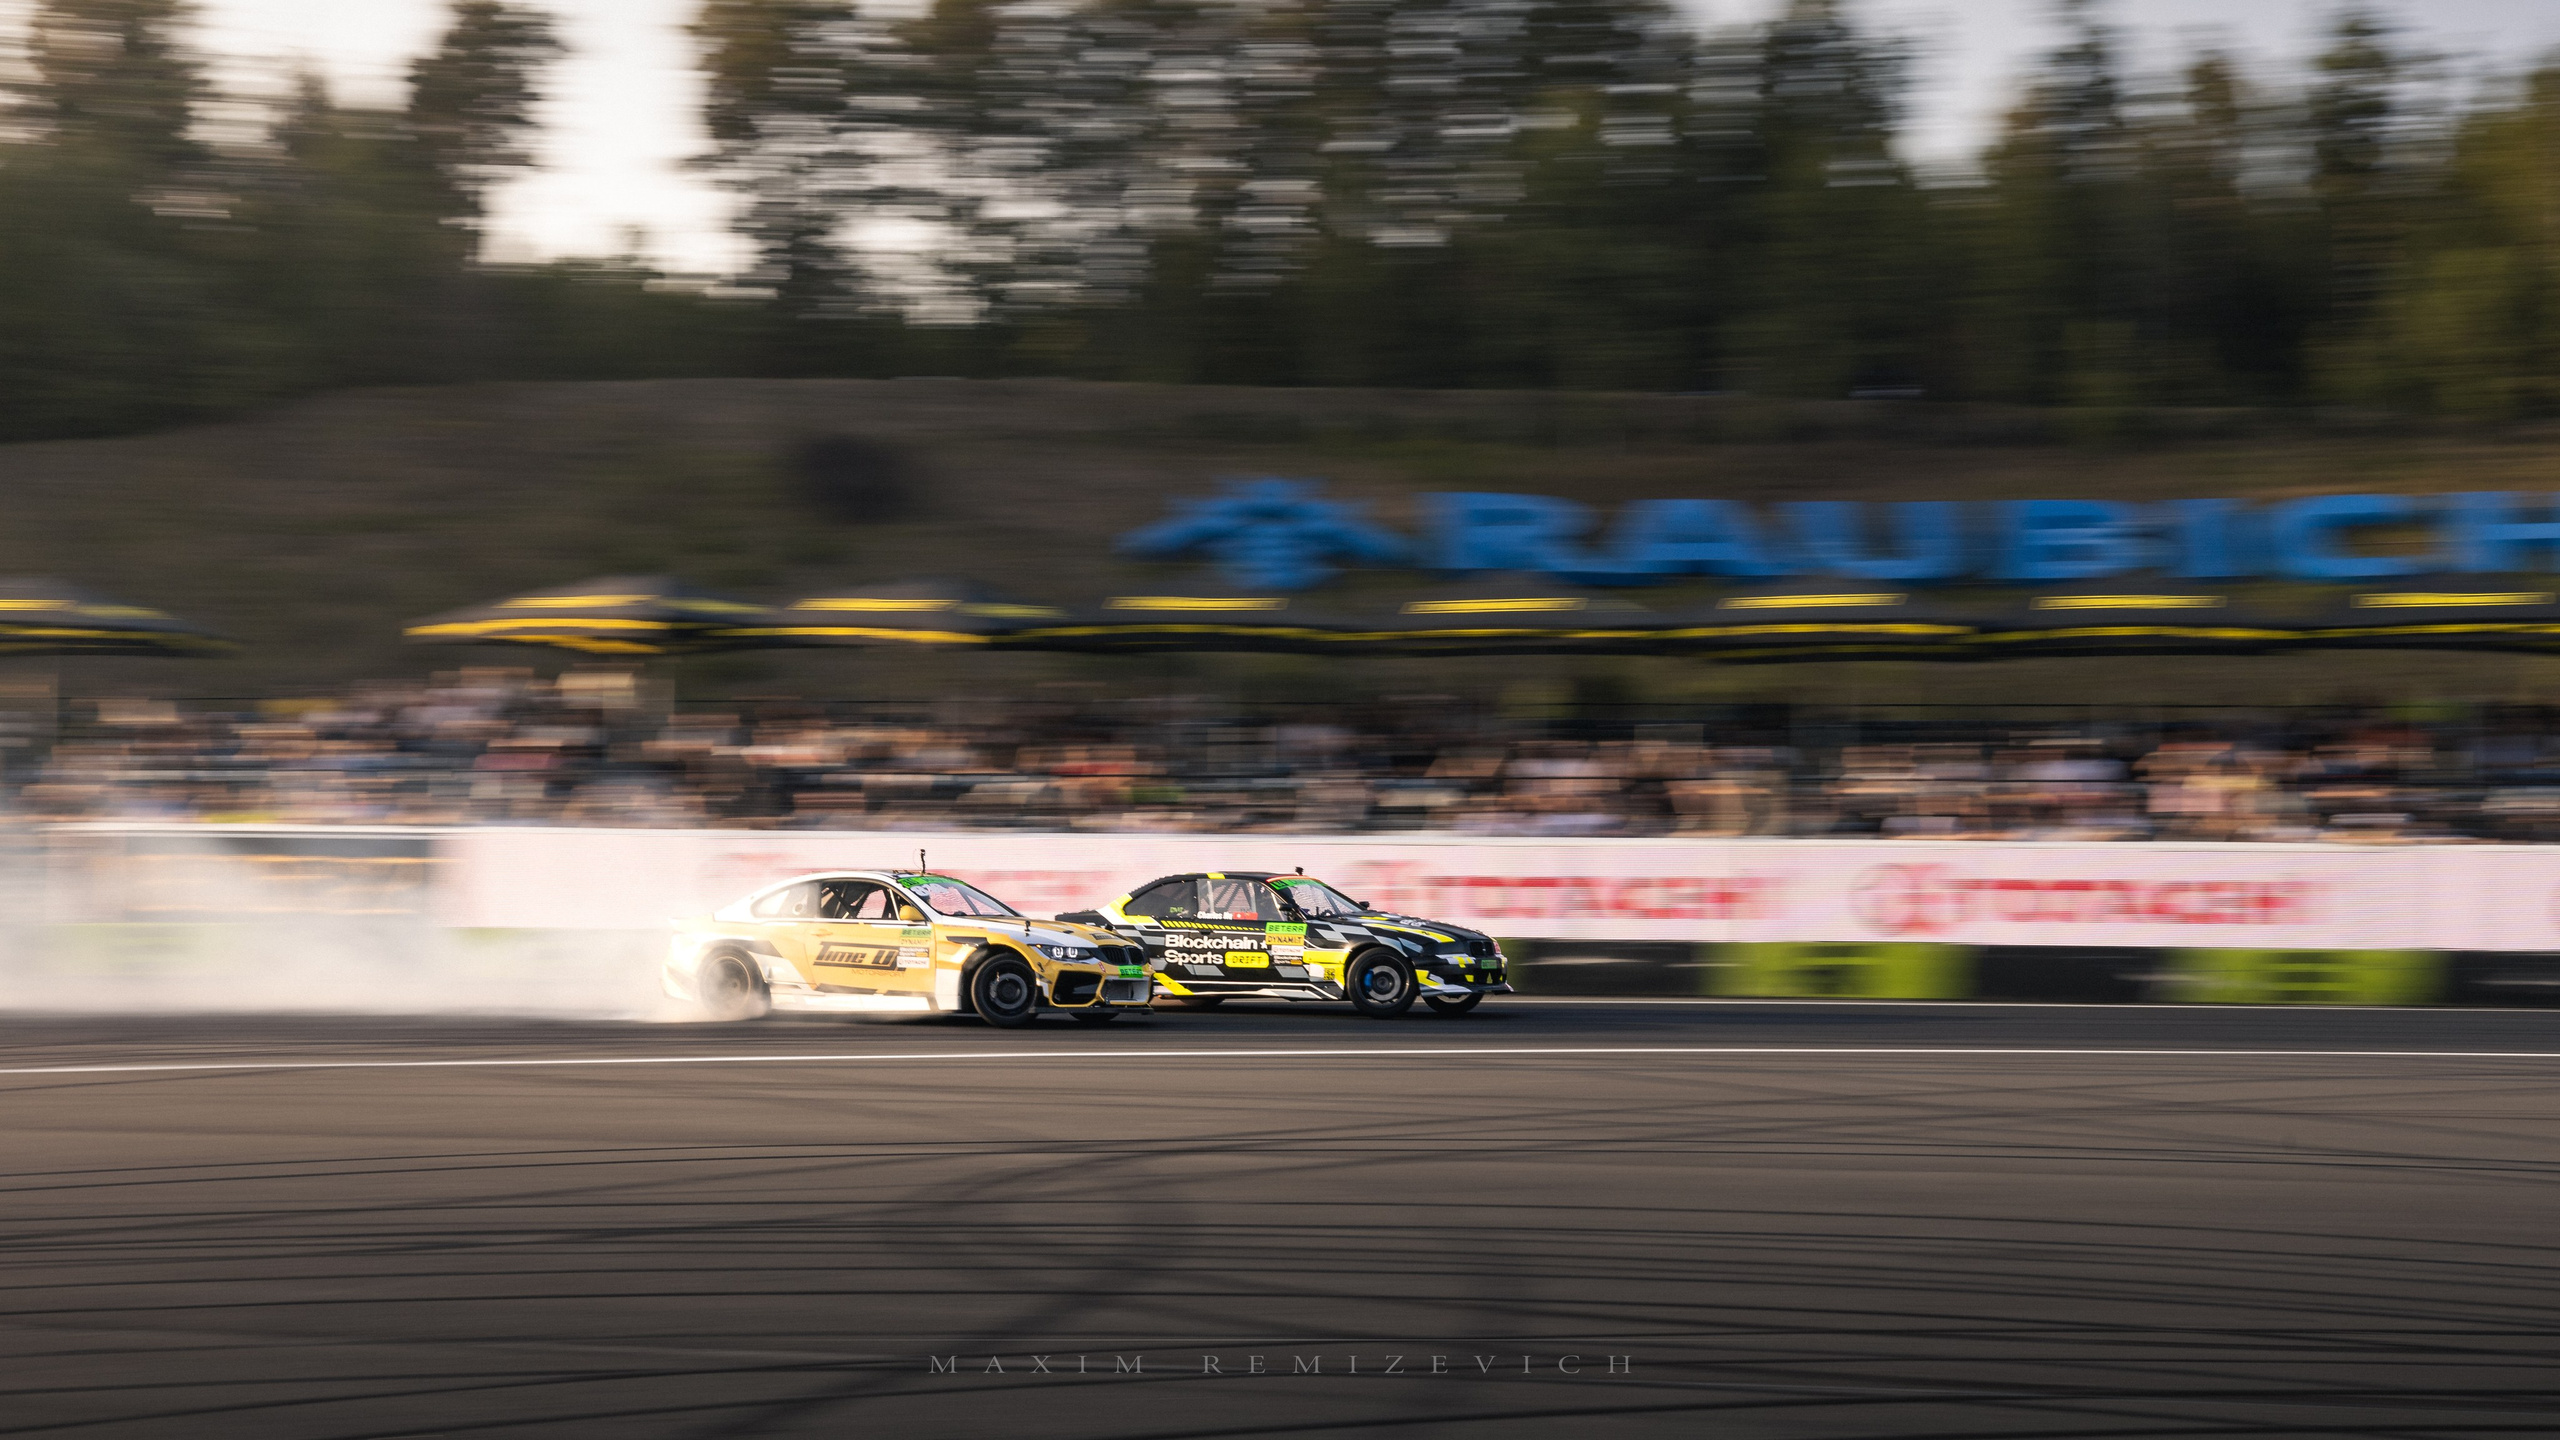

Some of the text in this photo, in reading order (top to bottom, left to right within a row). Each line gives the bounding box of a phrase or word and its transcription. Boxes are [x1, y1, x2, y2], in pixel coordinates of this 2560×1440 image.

[1164, 934, 1258, 949] Blockchain
[1164, 949, 1262, 965] Sports DRIFT
